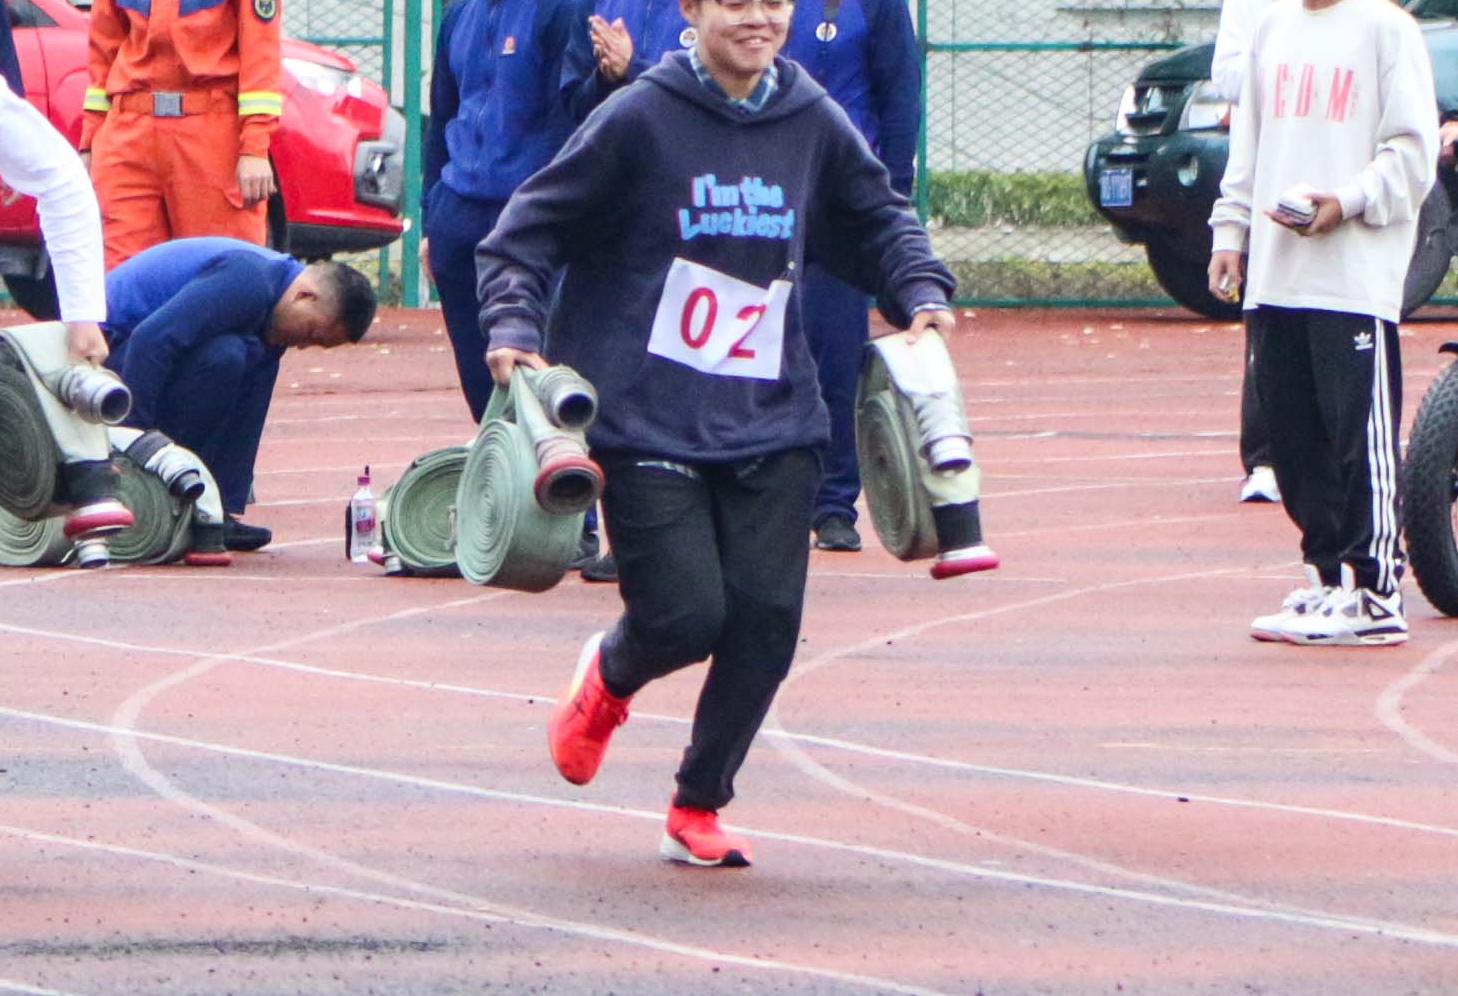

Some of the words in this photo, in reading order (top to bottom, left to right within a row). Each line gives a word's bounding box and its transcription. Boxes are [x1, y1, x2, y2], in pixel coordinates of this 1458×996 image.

[740, 176, 784, 208] the
[678, 207, 795, 241] Luckiest
[680, 286, 767, 359] 02
